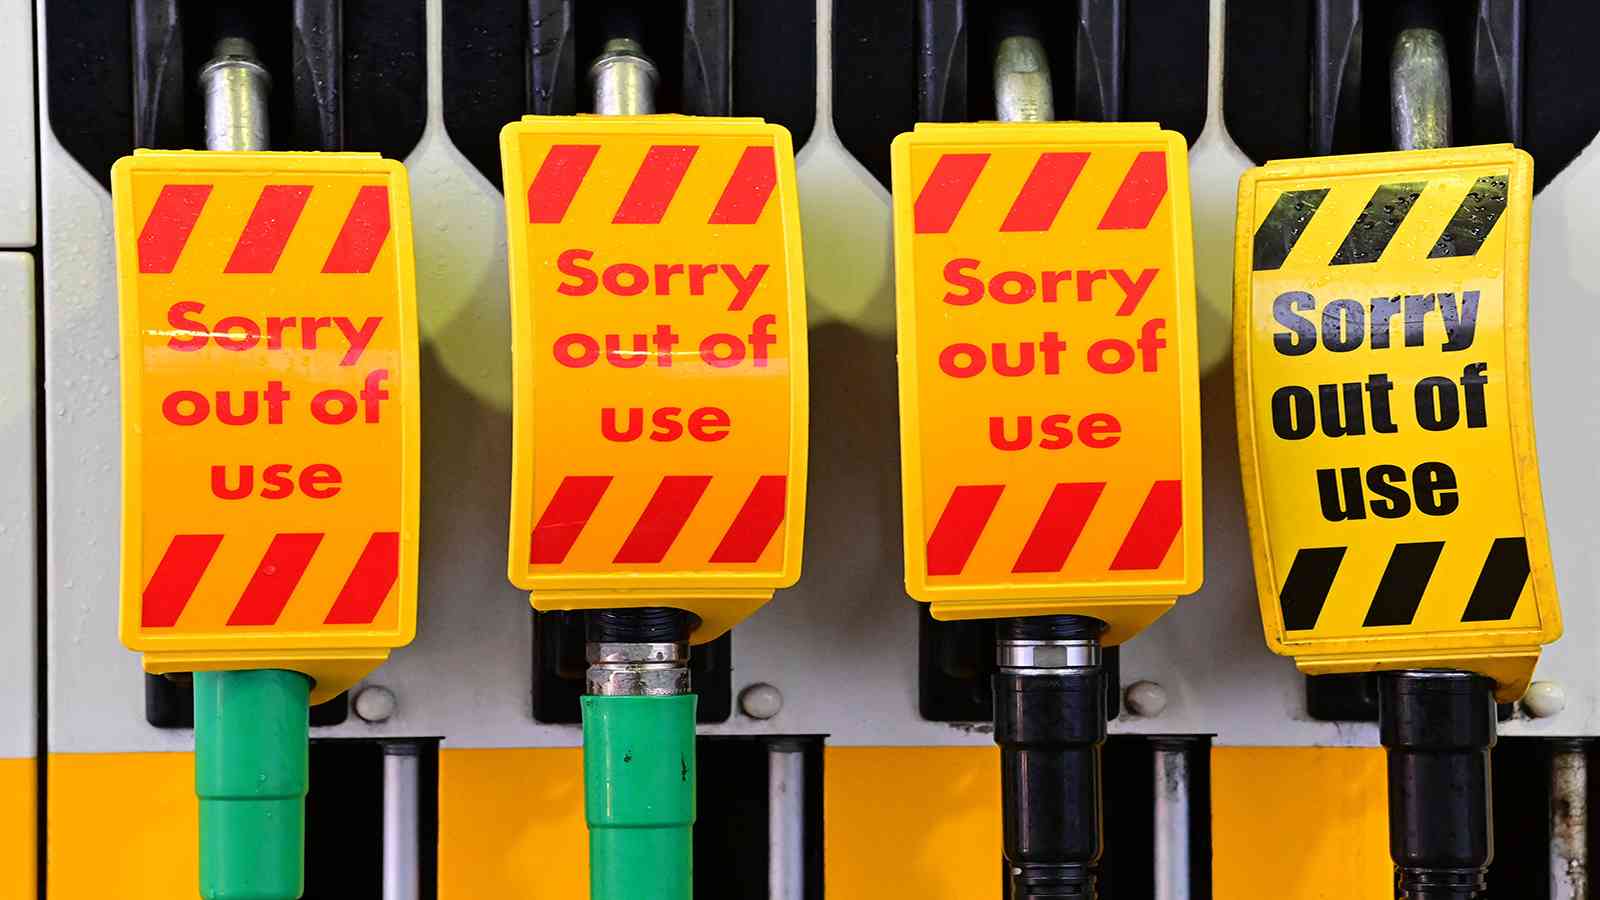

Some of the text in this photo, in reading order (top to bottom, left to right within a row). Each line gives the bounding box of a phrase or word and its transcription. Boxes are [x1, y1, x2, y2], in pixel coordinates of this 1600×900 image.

[557, 249, 769, 311] Sorry
[944, 259, 1159, 316] Sorry
[168, 301, 383, 366] Sorry
[553, 314, 776, 368] out of
[939, 319, 1166, 378] out of
[1273, 291, 1478, 356] Sorry
[162, 370, 389, 426] out of
[601, 407, 731, 442] use
[1272, 362, 1488, 440] out of
[989, 413, 1121, 451] use
[211, 464, 342, 500] use
[1316, 462, 1459, 522] use
